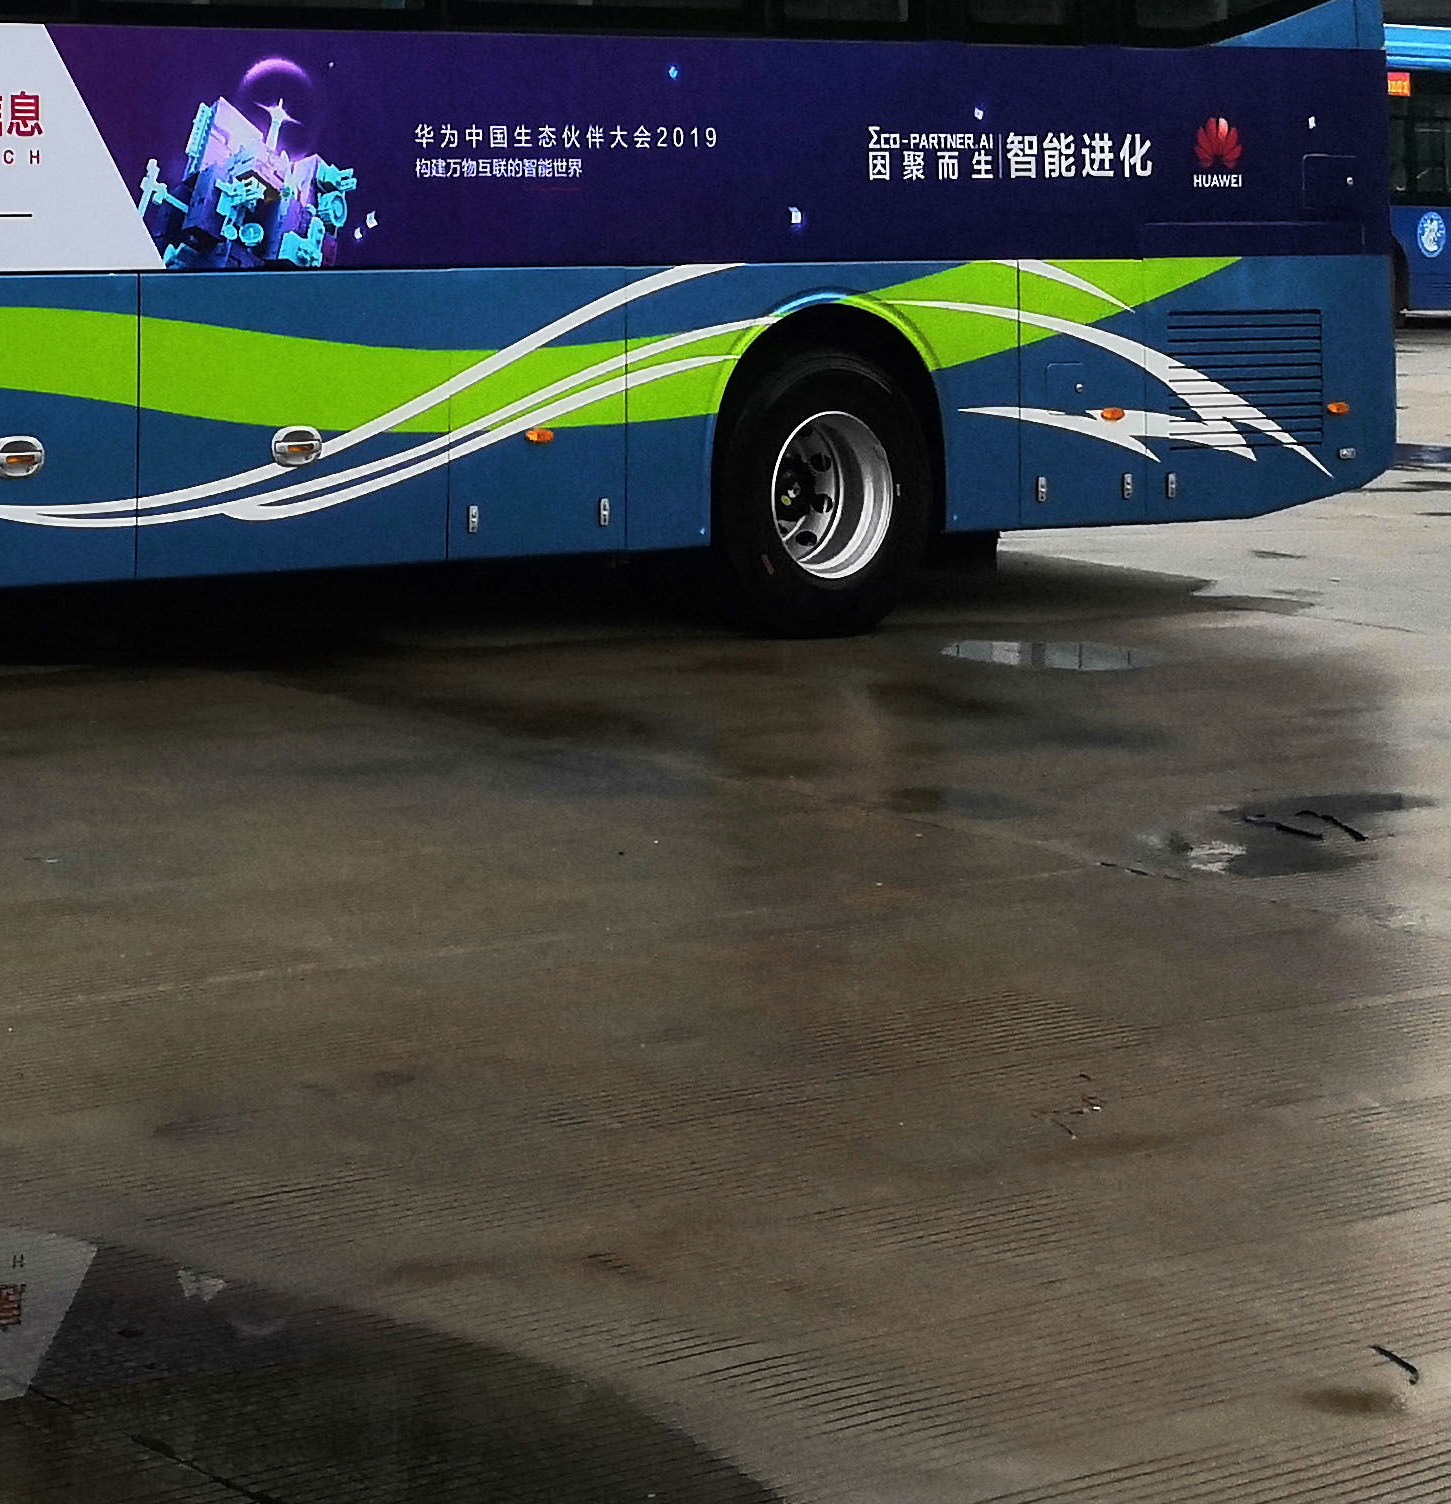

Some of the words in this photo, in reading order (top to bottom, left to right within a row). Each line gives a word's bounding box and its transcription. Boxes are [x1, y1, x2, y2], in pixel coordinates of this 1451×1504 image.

[414, 123, 718, 149] 华为中国生态伙伴大会2019
[415, 157, 583, 179] 构建万物互联的智能世界
[867, 150, 994, 181] 因聚而生
[1006, 131, 1154, 179] 智能进化
[1192, 173, 1243, 189] HUAWEI
